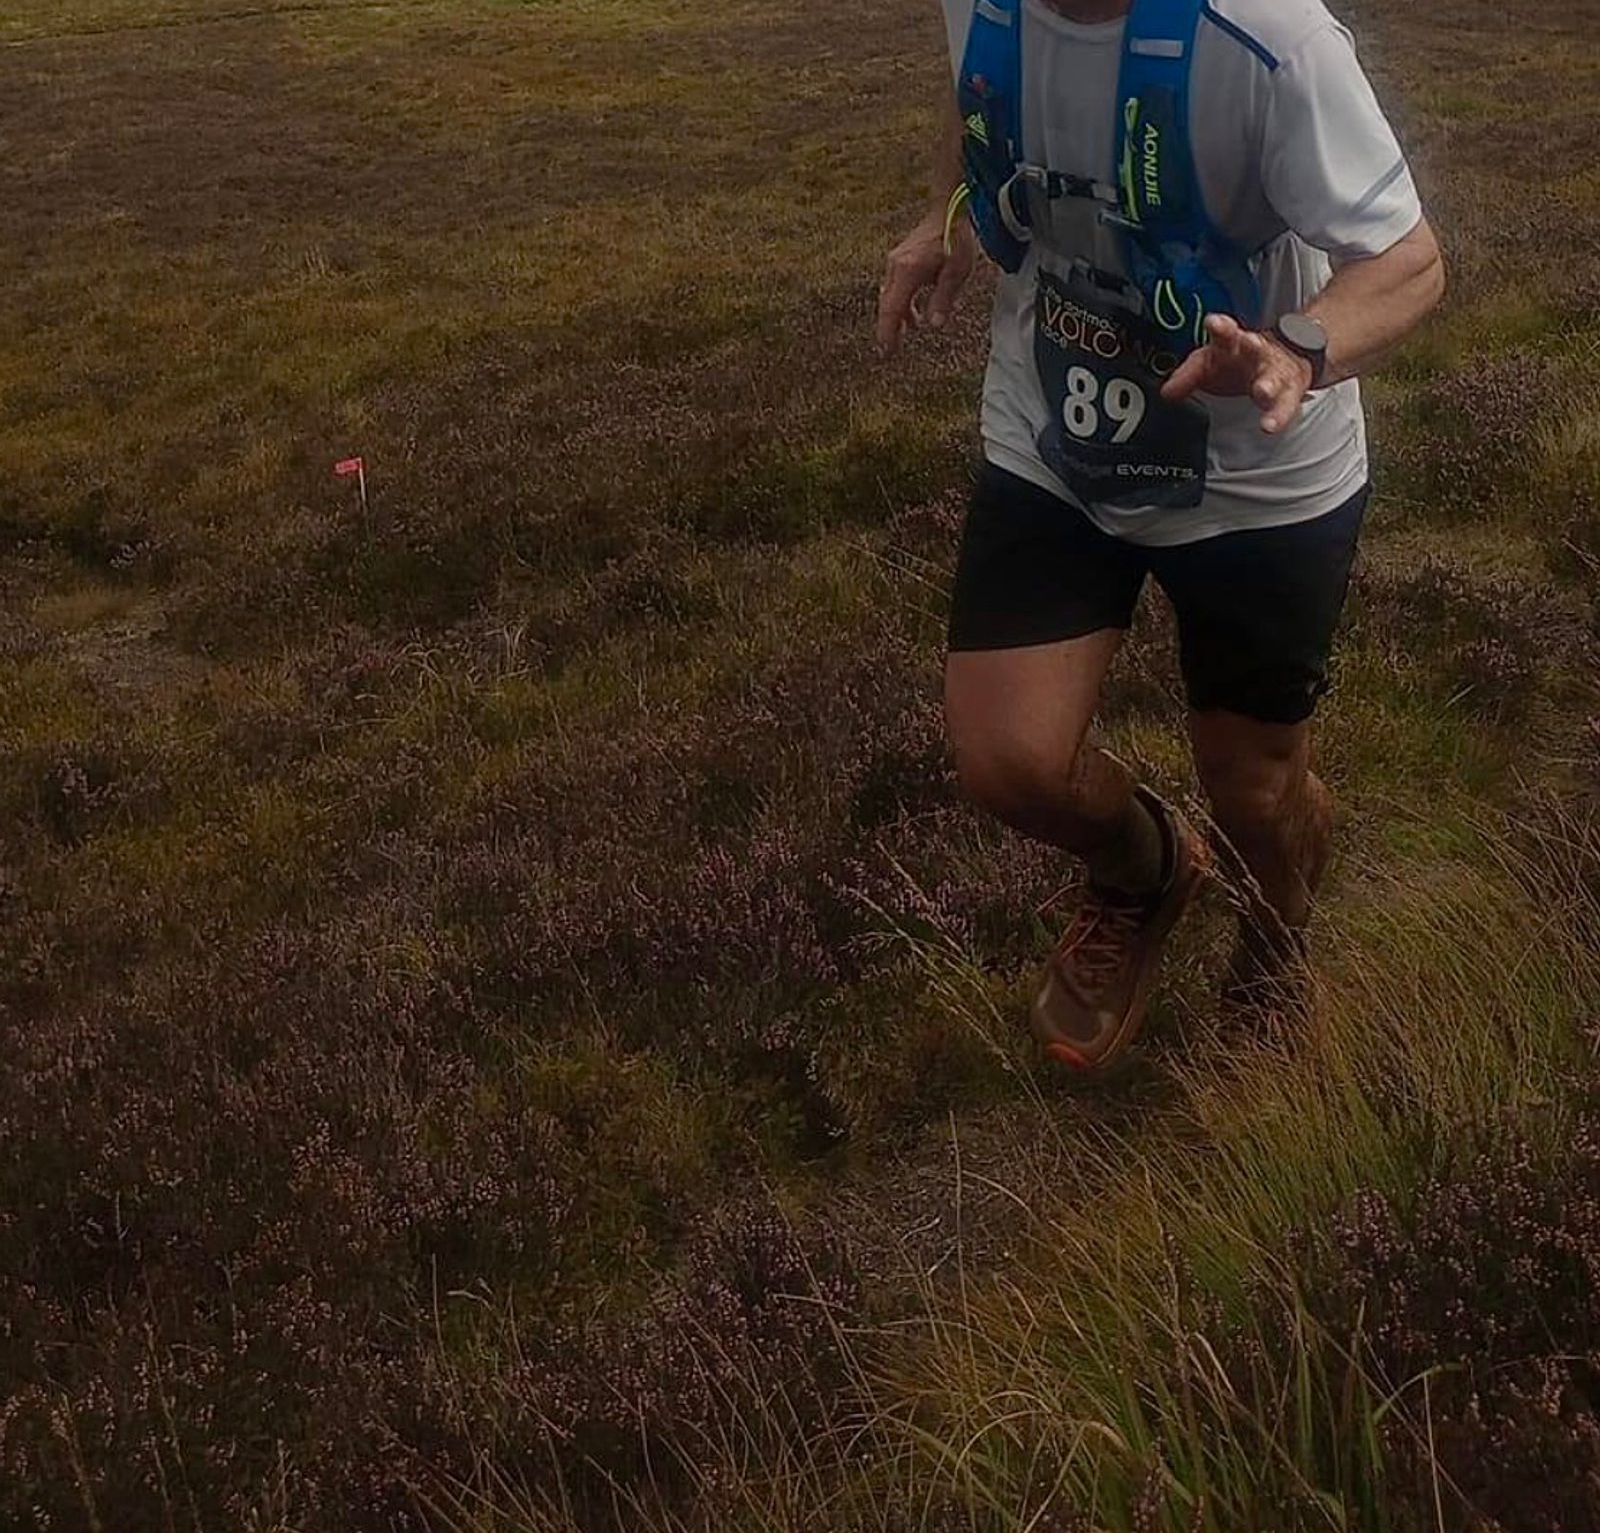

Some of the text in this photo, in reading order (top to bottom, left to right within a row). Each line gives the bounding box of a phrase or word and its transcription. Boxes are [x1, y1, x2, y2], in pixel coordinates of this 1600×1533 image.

[1143, 122, 1162, 207] AONIJIE
[1044, 295, 1178, 377] VOLCNO
[1063, 366, 1146, 444] 89
[1116, 463, 1195, 479] EVENTS
